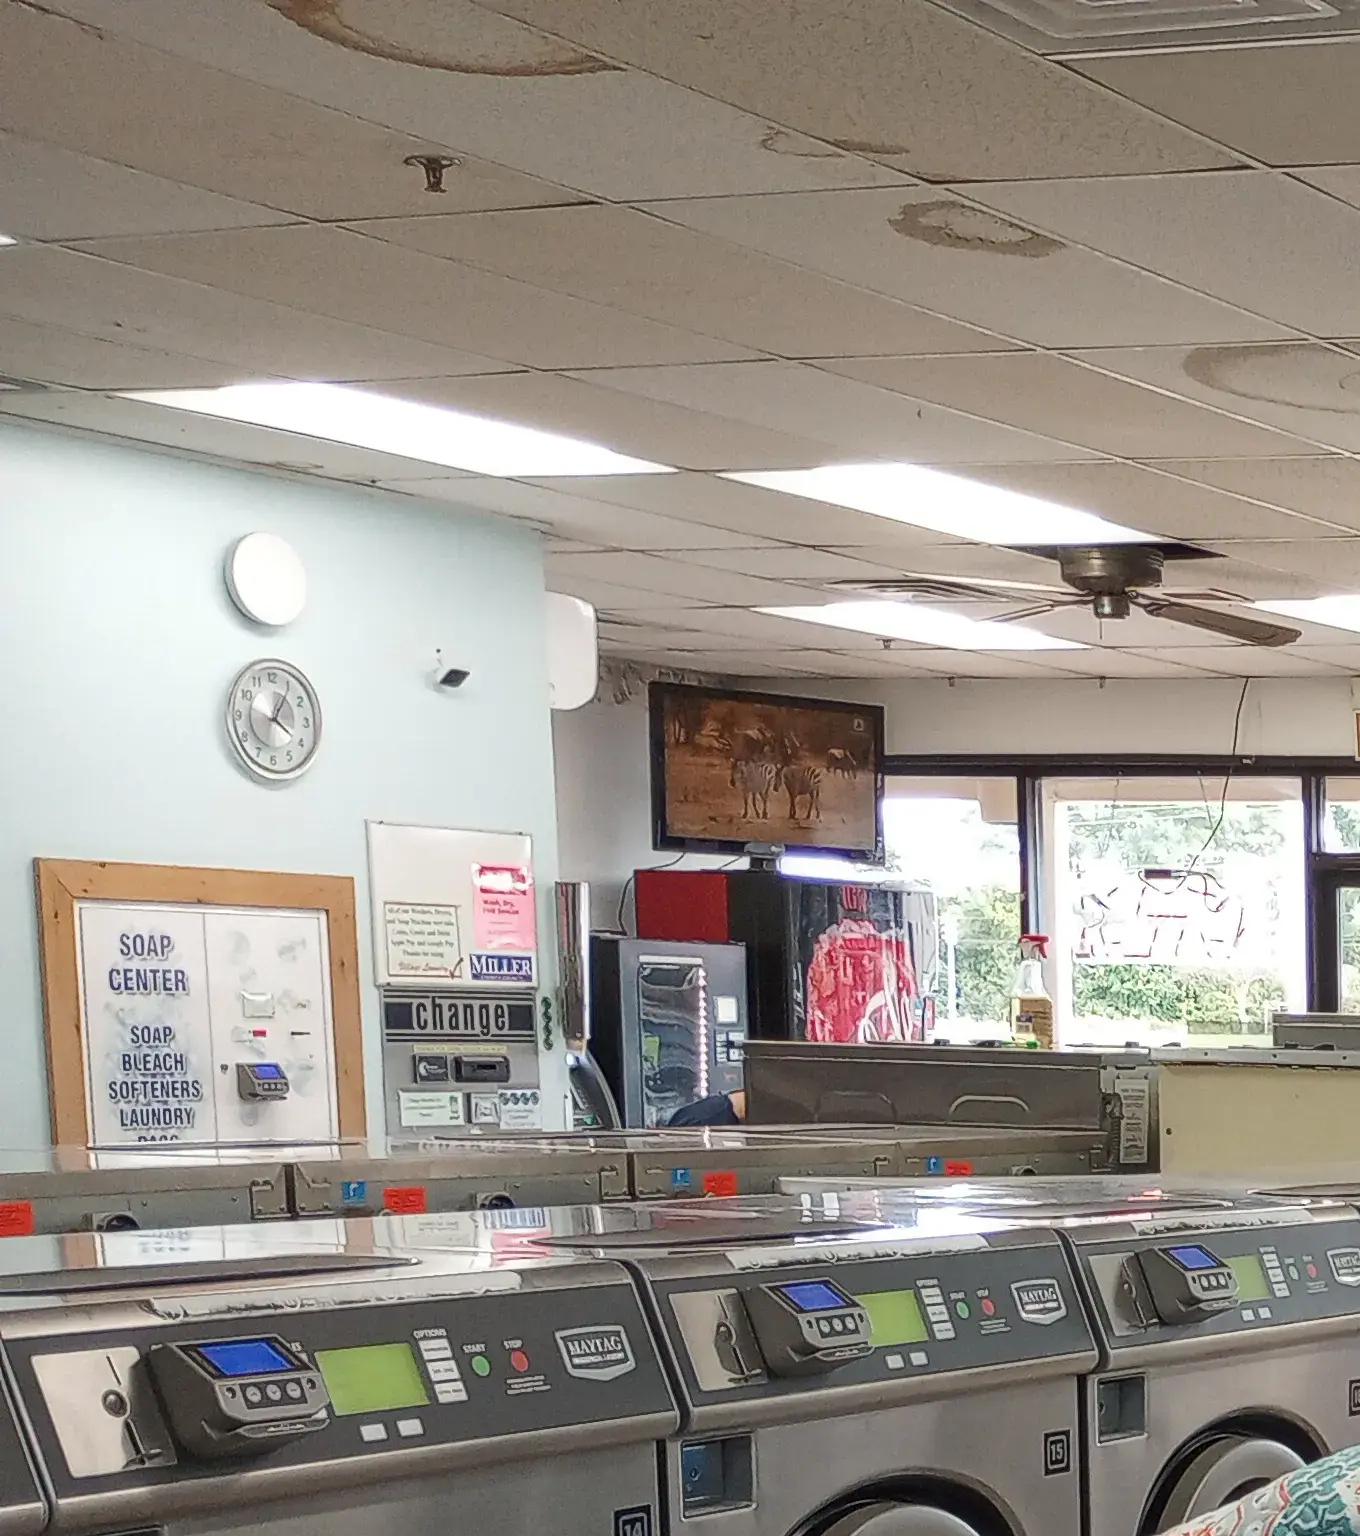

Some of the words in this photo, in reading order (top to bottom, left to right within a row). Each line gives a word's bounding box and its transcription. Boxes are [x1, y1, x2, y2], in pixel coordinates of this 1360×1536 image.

[252, 676, 261, 687] 11
[267, 672, 278, 684] 12
[241, 689, 252, 701] 10
[296, 696, 304, 708] 2
[235, 710, 242, 721] 9
[303, 717, 310, 728] 3
[241, 731, 248, 742] 8
[297, 738, 304, 748] 4
[256, 747, 262, 758] 7
[286, 750, 293, 762] 5
[270, 756, 277, 766] 6
[119, 933, 172, 957] SOAP
[471, 955, 532, 976] MILLER
[108, 968, 187, 992] CENTER
[415, 996, 506, 1037] change
[130, 1025, 173, 1044] SOAP
[122, 1053, 185, 1072] BLEACH
[108, 1079, 201, 1099] SOFTENERS
[119, 1108, 193, 1127] LAUNDRY
[1019, 1288, 1057, 1303] MAYTAG
[462, 1343, 486, 1353] START
[566, 1335, 622, 1356] MAYTAG
[1050, 1442, 1064, 1461] 15
